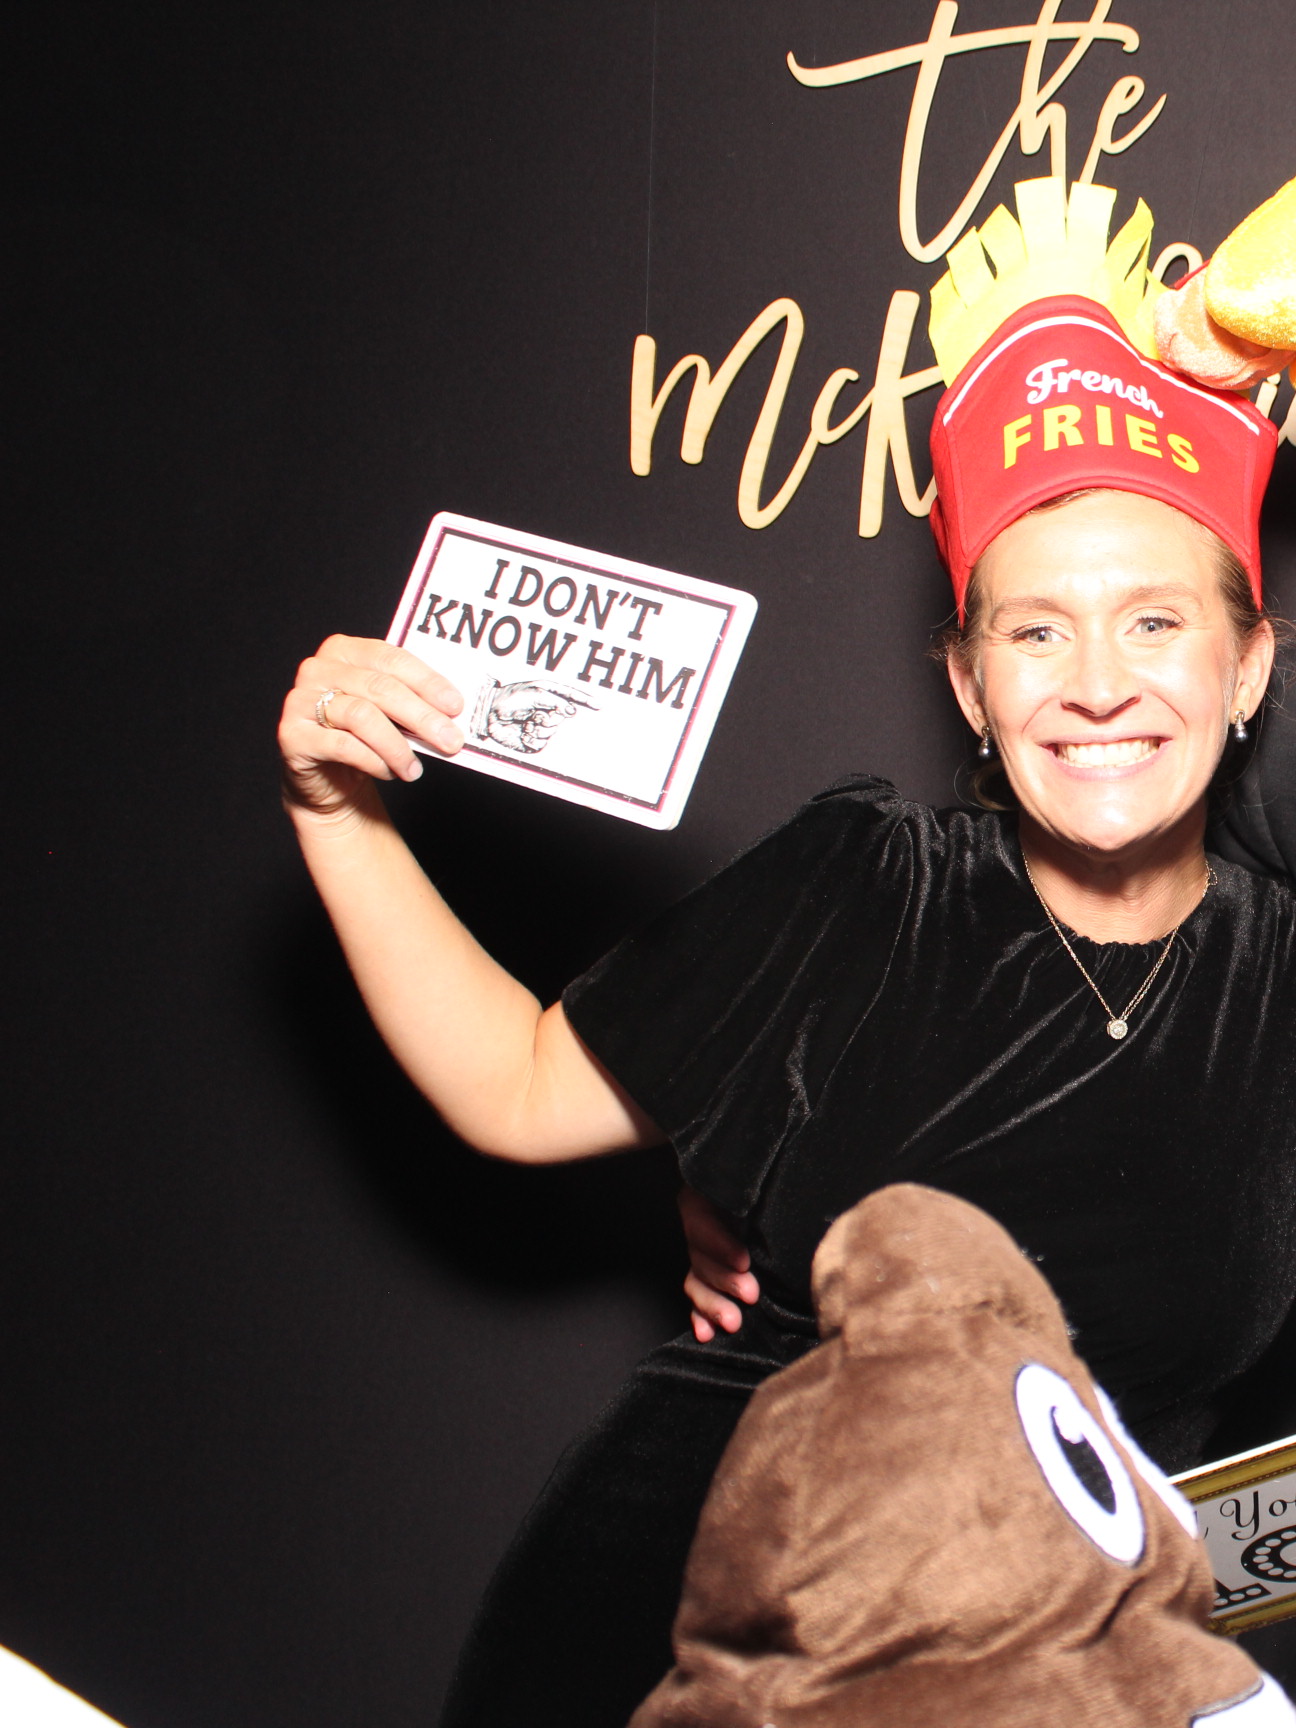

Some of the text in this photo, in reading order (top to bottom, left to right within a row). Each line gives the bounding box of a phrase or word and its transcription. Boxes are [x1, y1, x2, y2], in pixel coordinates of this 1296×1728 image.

[786, 0, 1167, 263] the
[1025, 358, 1164, 419] French
[1003, 404, 1200, 474] FRIES
[484, 558, 663, 641] I DON'T
[417, 593, 697, 710] KNOW HIM
